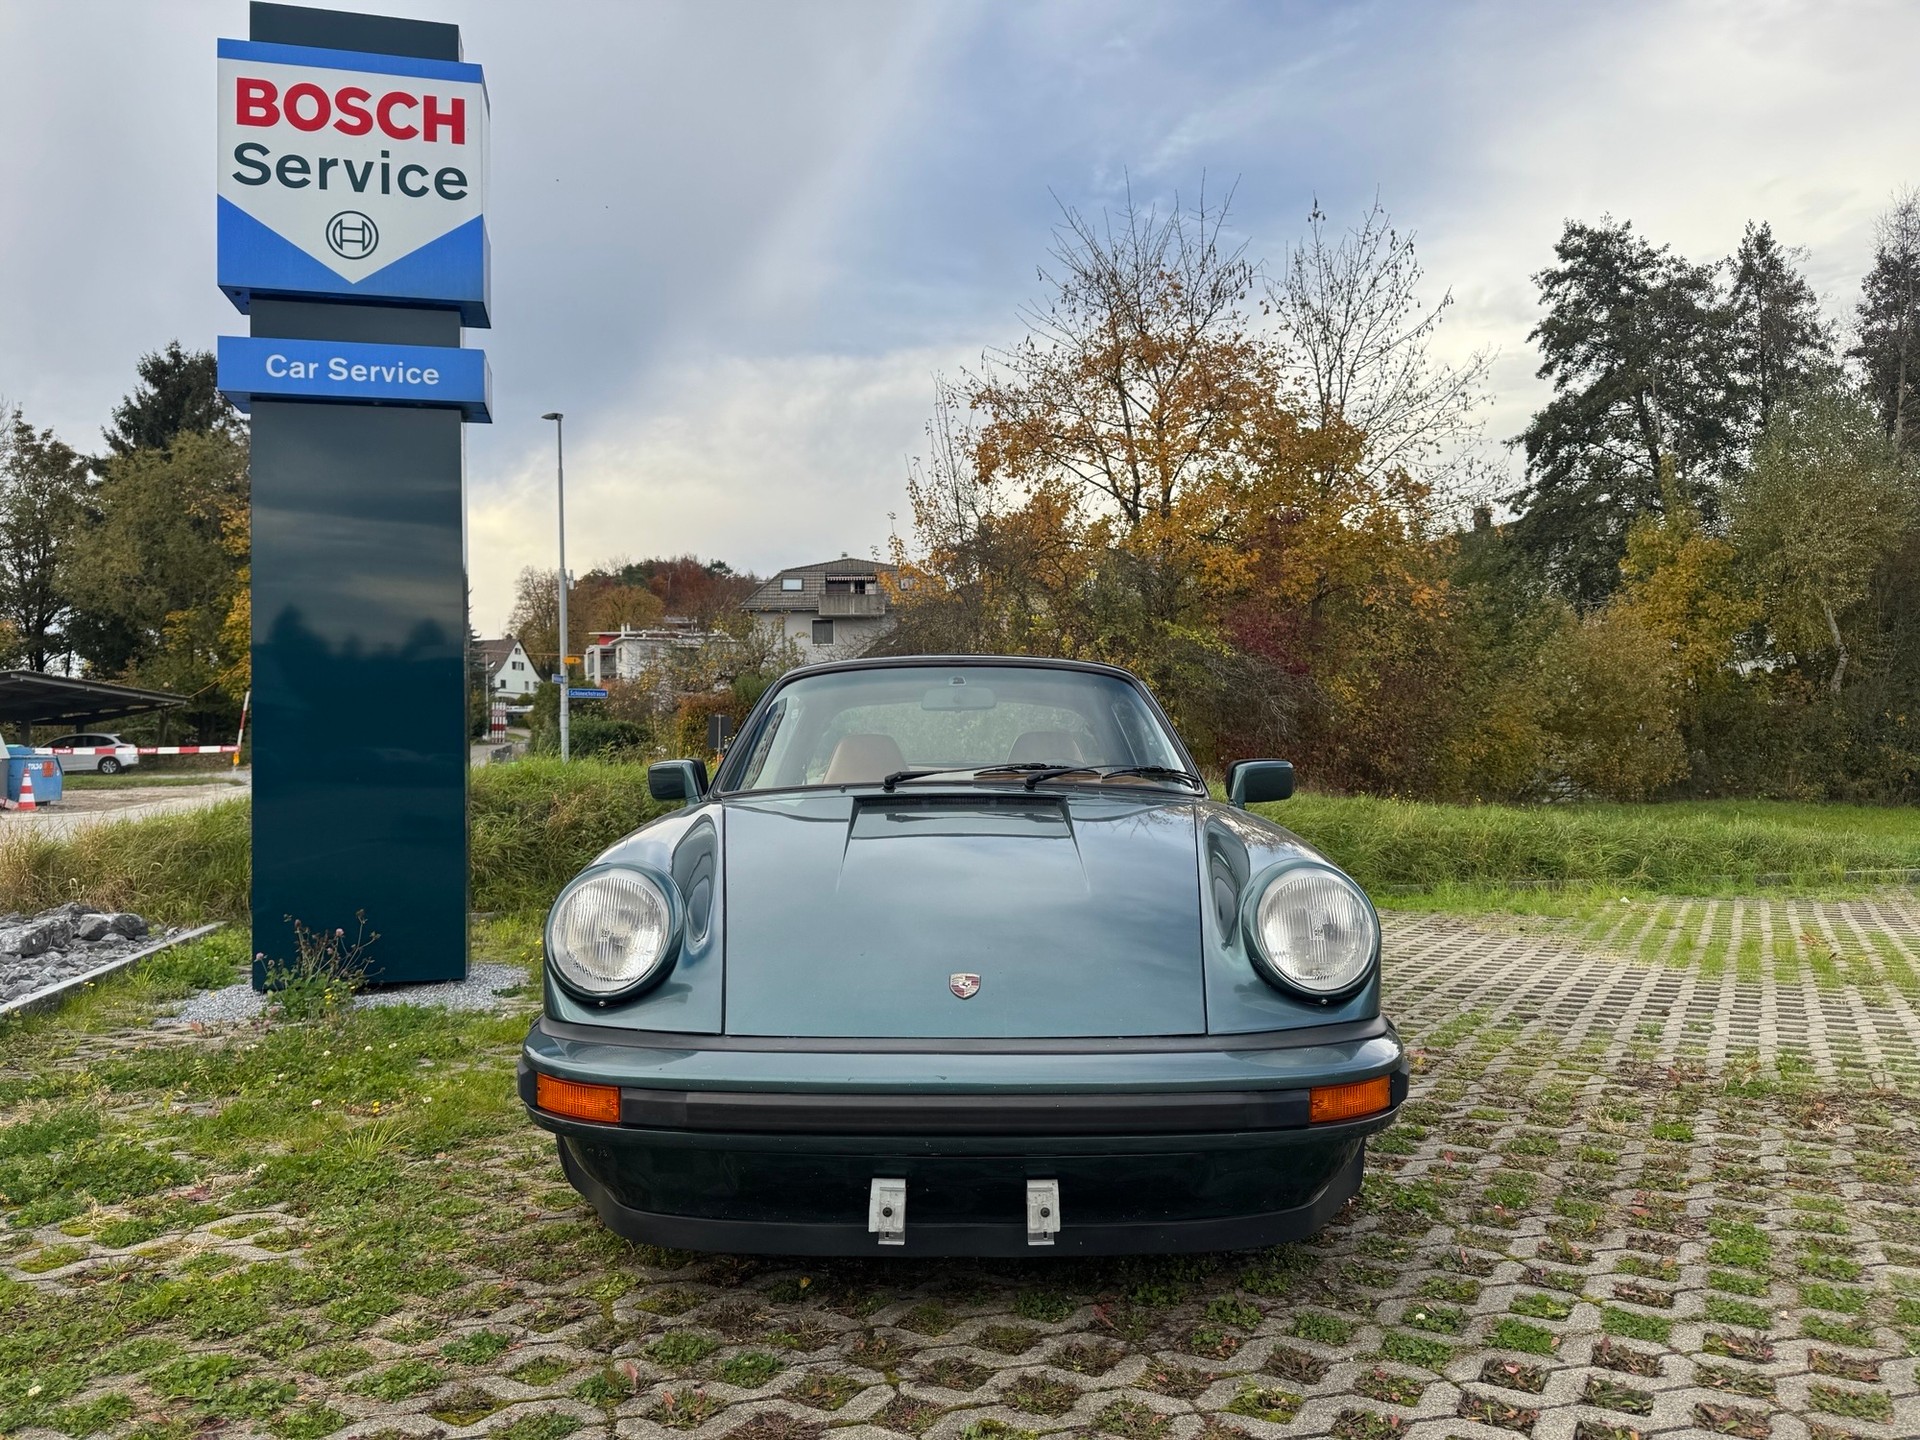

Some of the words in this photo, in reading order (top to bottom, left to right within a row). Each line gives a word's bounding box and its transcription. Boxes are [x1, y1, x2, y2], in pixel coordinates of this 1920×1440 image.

[236, 77, 466, 145] BOSCH
[232, 142, 468, 200] Service
[265, 353, 319, 380] Car
[327, 357, 440, 385] Service
